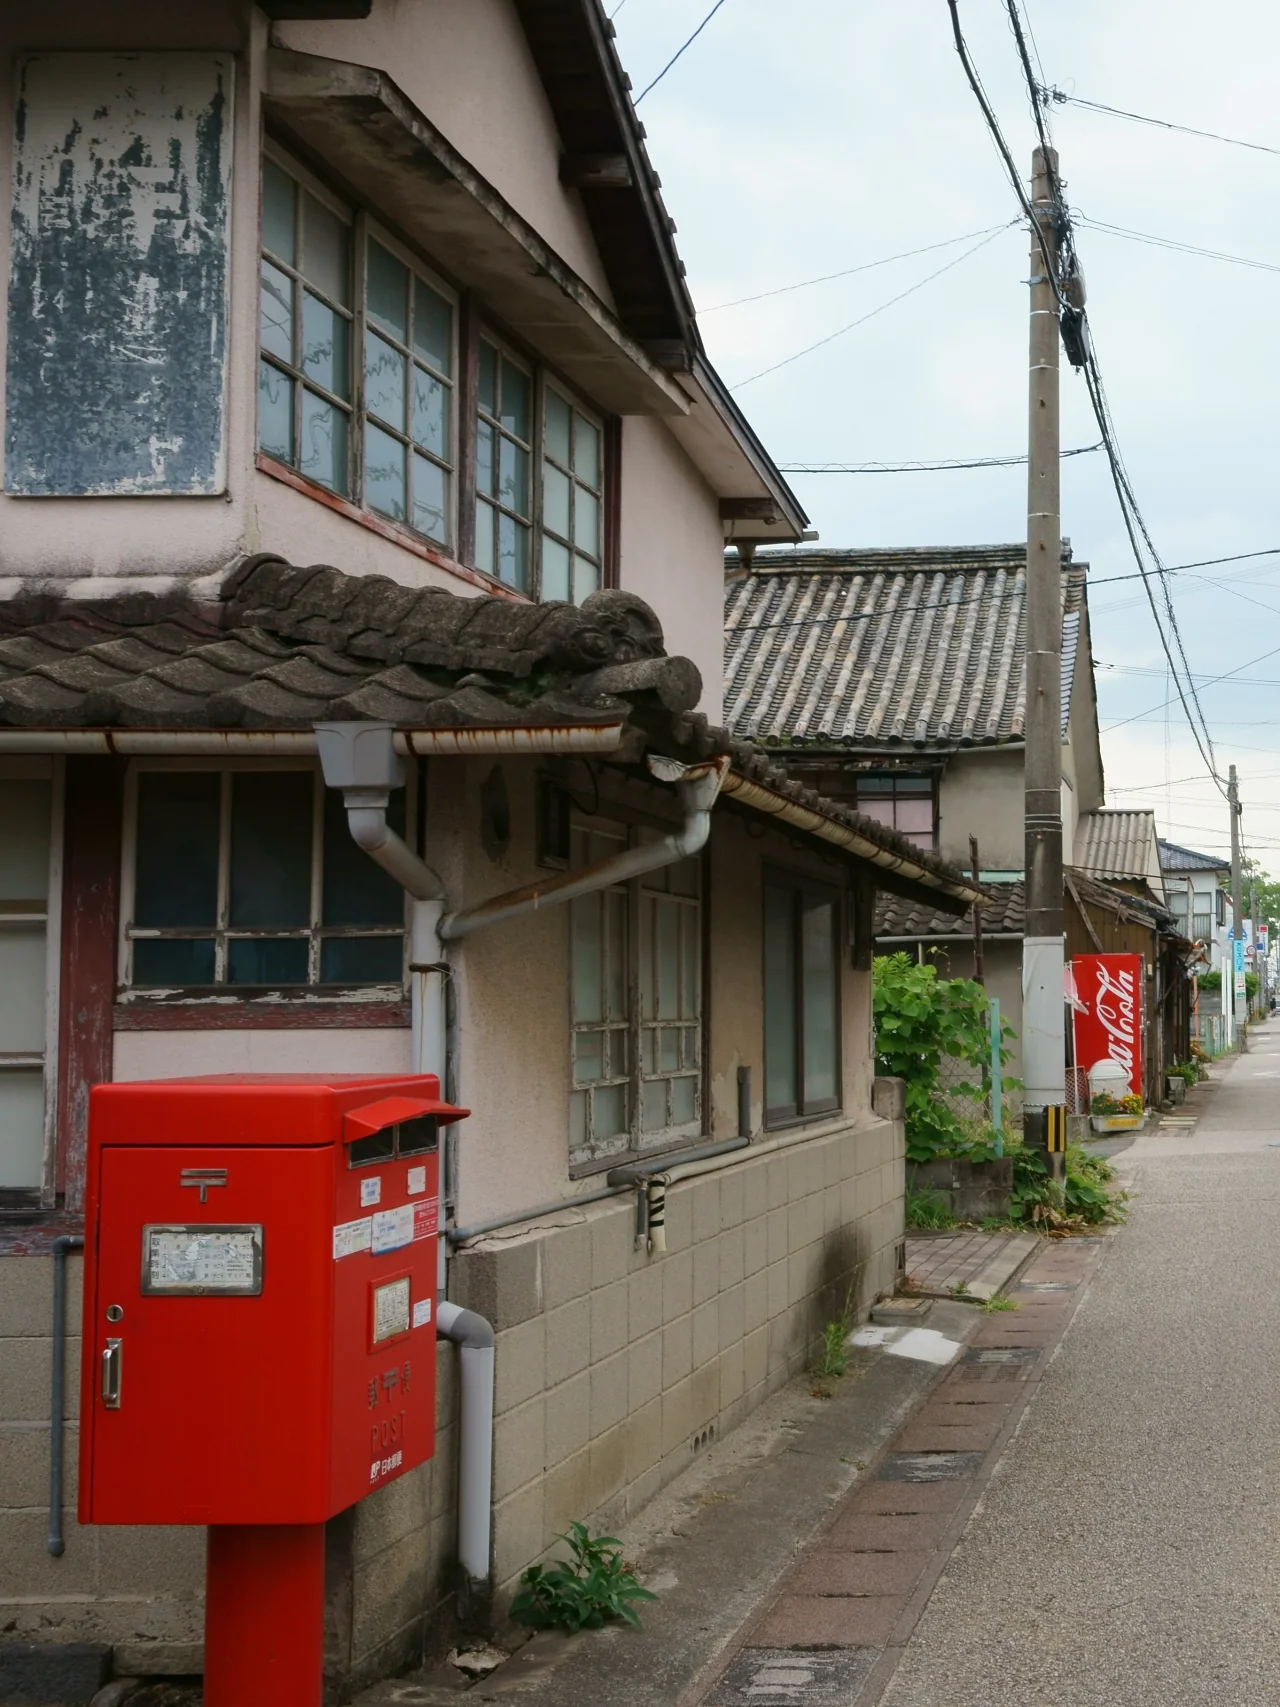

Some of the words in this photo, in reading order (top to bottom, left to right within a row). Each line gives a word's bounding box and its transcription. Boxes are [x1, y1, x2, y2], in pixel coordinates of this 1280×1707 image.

[371, 1410, 406, 1454] POST
[381, 1450, 403, 1476] 日本郵便
